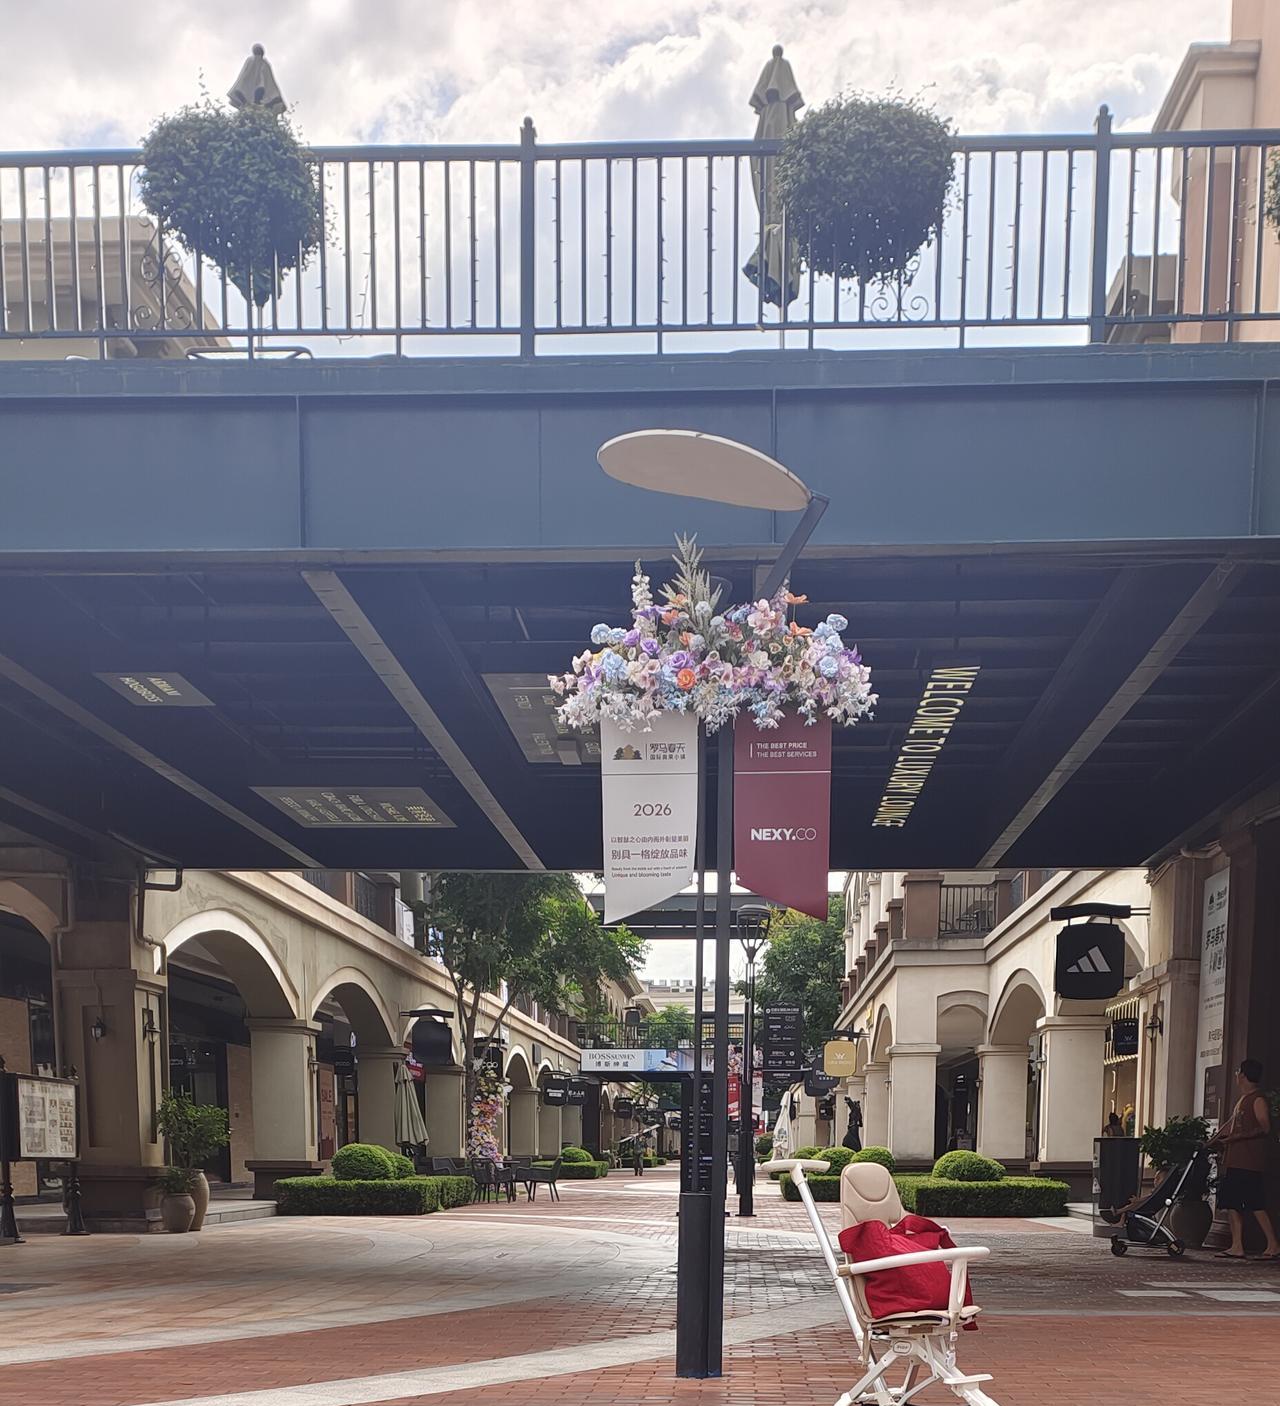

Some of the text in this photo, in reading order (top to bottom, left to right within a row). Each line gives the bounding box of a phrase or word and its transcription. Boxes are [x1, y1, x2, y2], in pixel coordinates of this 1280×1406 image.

[788, 741, 808, 749] PRICE
[871, 665, 981, 828] WELCOME TO LUXURY LOUNGE
[786, 750, 817, 758] SERVICES
[633, 803, 672, 816] 2026
[750, 827, 817, 841] NEXY.CO
[611, 848, 688, 860] 别具一格绽放品味
